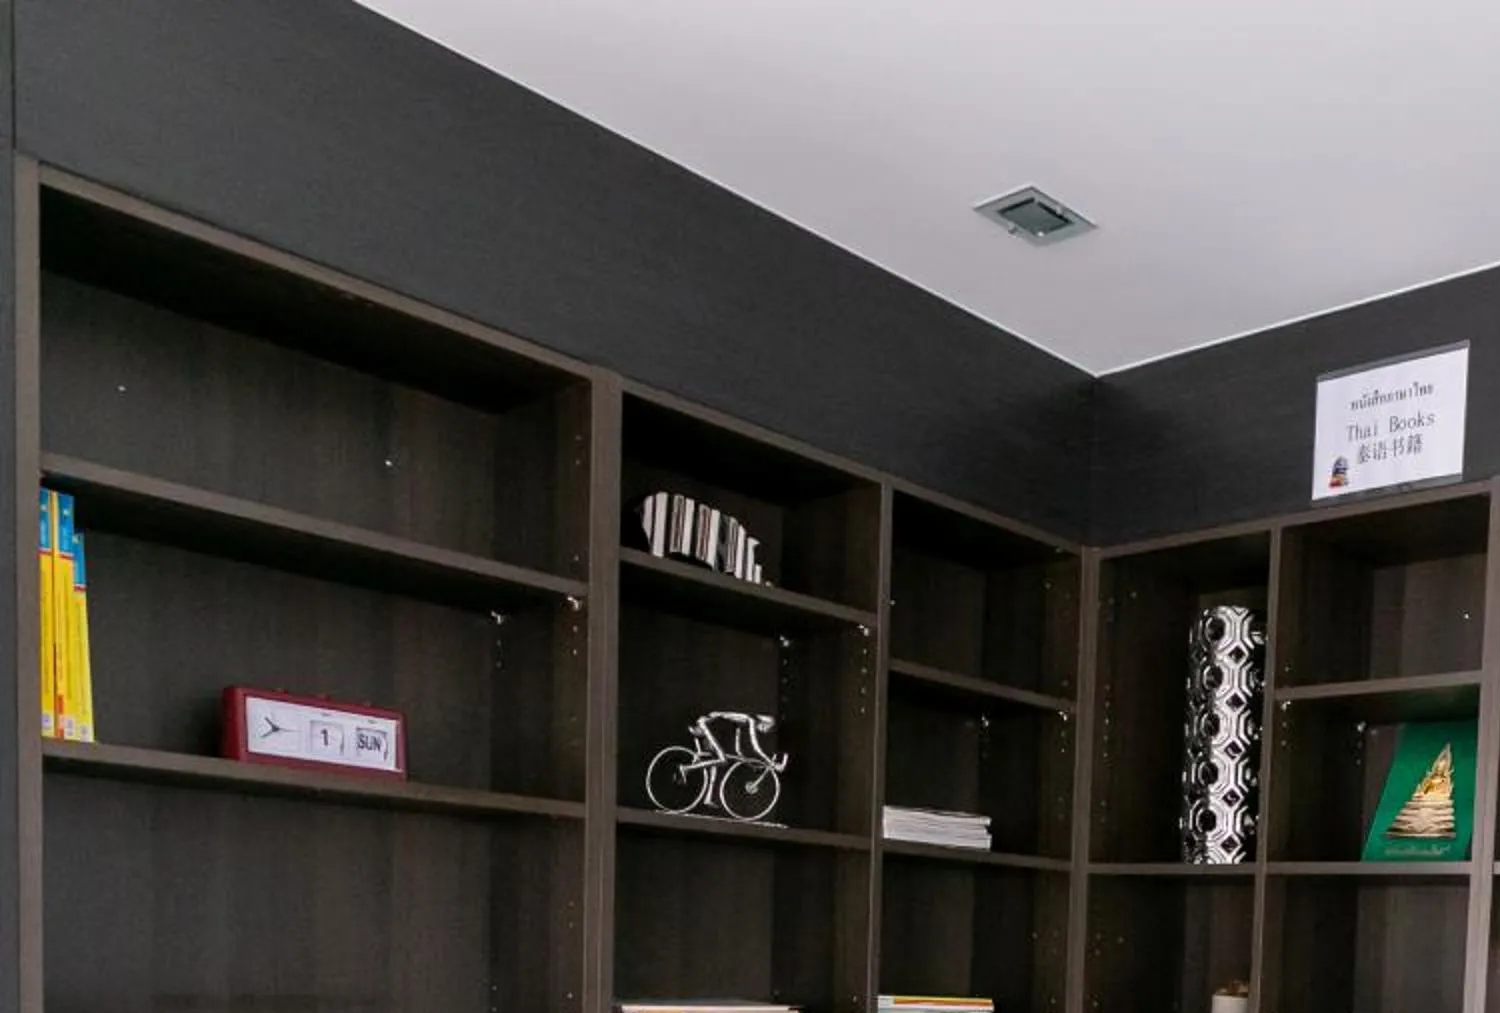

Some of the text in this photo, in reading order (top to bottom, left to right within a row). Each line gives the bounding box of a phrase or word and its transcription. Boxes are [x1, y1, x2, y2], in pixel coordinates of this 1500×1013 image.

[1347, 412, 1436, 442] Thai Books
[357, 732, 382, 752] SUN
